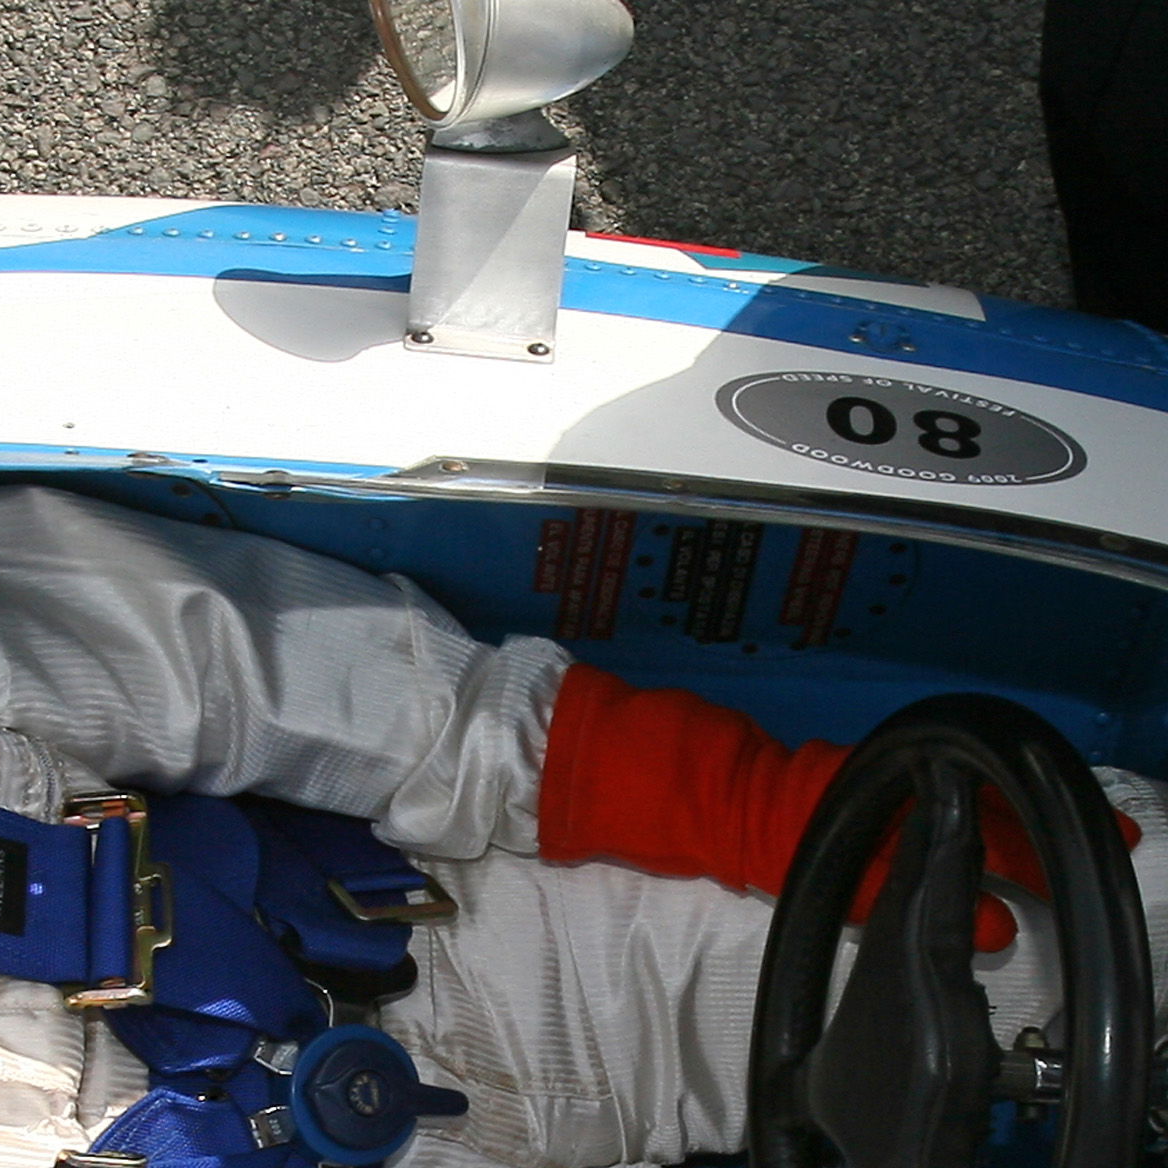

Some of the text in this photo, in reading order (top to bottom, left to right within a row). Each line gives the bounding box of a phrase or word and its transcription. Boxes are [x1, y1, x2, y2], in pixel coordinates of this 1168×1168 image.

[781, 372, 1016, 416] FESTIVAL OF SPEED
[826, 397, 982, 460] 80
[791, 442, 1022, 484] 2009 GOODWOOD
